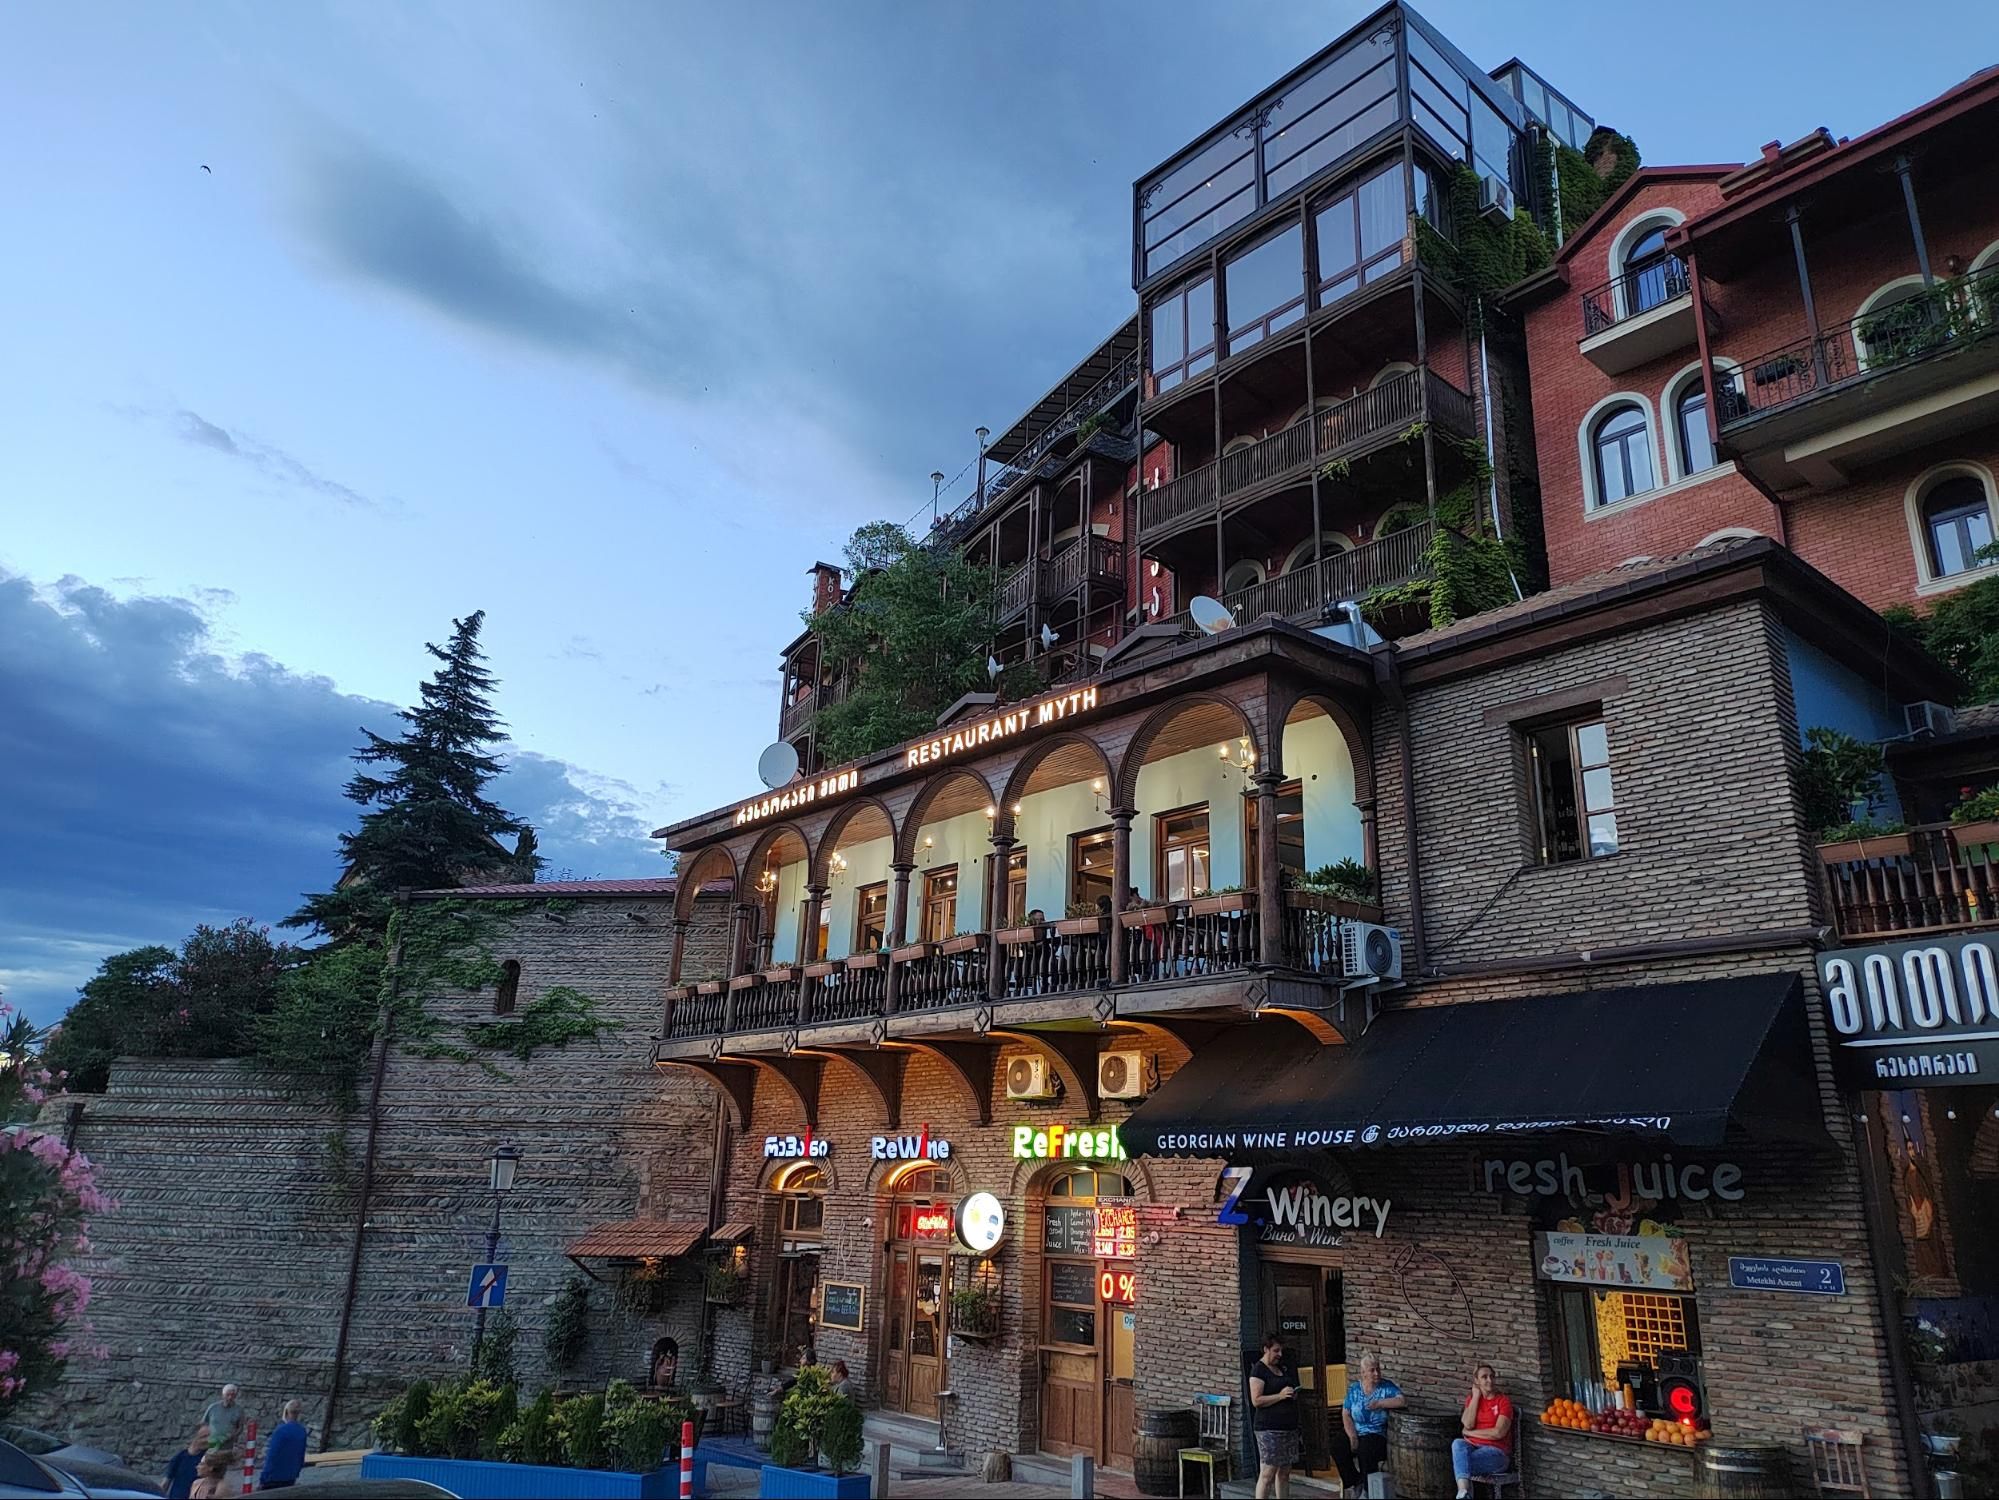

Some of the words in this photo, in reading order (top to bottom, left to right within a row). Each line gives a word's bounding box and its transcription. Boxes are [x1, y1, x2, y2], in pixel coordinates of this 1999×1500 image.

[907, 709, 1031, 769] RESTAURANT
[1038, 687, 1097, 725] MYTH
[736, 784, 816, 825] რესტორანი
[820, 770, 858, 798] მითი
[1875, 1053, 1978, 1078] რესტორანი
[1157, 1132, 1236, 1149] GEORGIAN
[1242, 1132, 1287, 1148] WINE
[1294, 1129, 1357, 1147] HOUSE
[1387, 1122, 1491, 1139] ქართული
[1013, 1124, 1127, 1161] ReFresh
[1604, 1152, 1745, 1210] Juice
[1266, 1185, 1391, 1239] Winery
[1260, 1224, 1296, 1242] Вино
[1309, 1225, 1344, 1247] Wine
[1553, 1236, 1575, 1246] coffee
[1584, 1235, 1612, 1248] Fresh
[1614, 1237, 1641, 1249] Juice
[1101, 1272, 1114, 1299] 0
[1119, 1274, 1135, 1301] %
[1819, 1267, 1832, 1284] 2
[1282, 1321, 1307, 1330] OPEN
